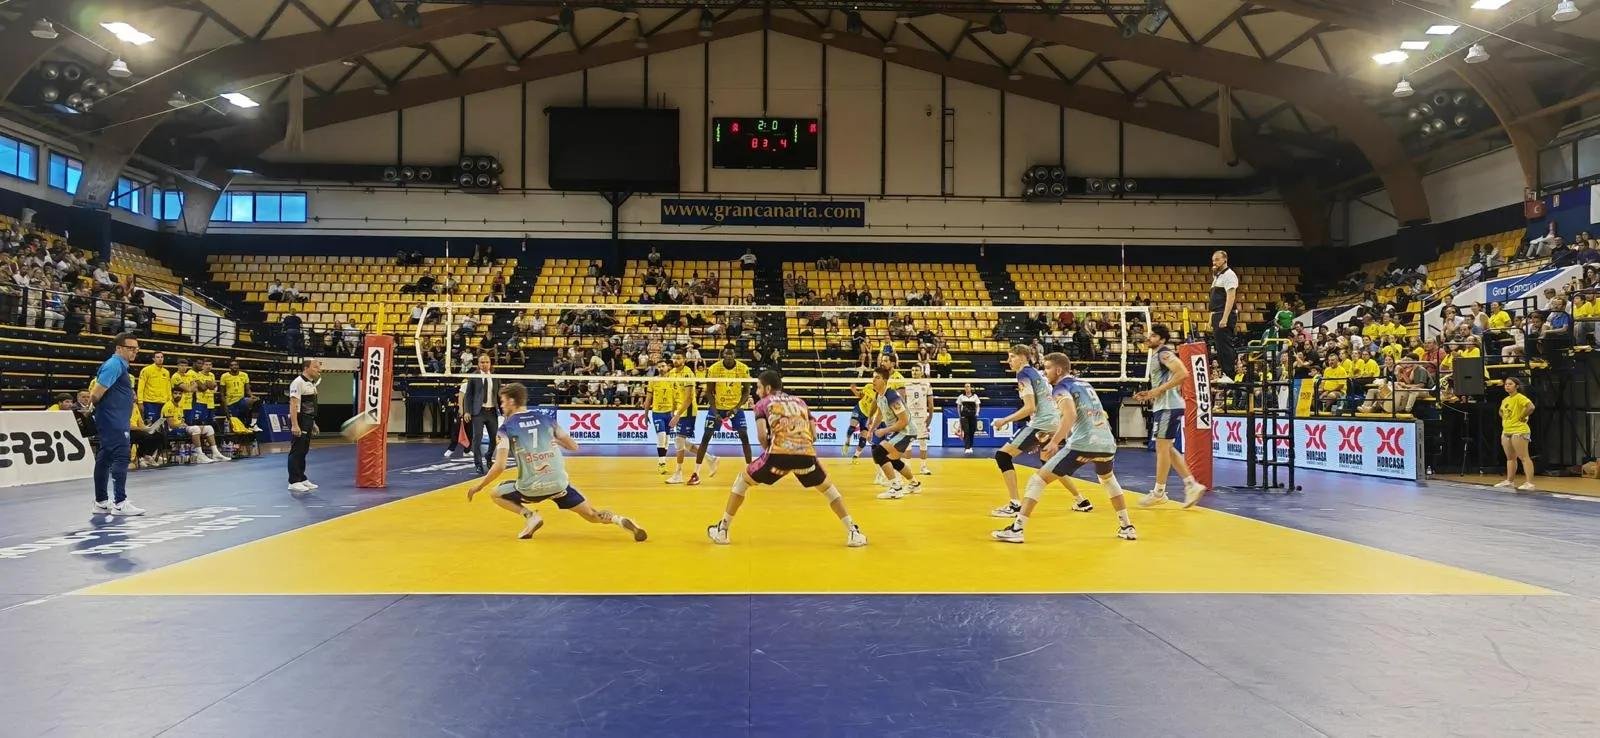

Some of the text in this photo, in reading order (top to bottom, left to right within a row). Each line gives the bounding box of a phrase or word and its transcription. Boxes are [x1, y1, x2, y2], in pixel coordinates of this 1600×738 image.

[780, 139, 788, 148] 4
[663, 202, 861, 221] www.grancanaria.com
[528, 428, 538, 449] 7
[570, 431, 600, 439] HORCASA
[618, 431, 648, 439] HORCASA
[713, 431, 741, 439] HORCAS
[1306, 450, 1327, 462] HORCASA
[1339, 453, 1363, 466] HORCASA
[1377, 456, 1405, 470] HORCASA
